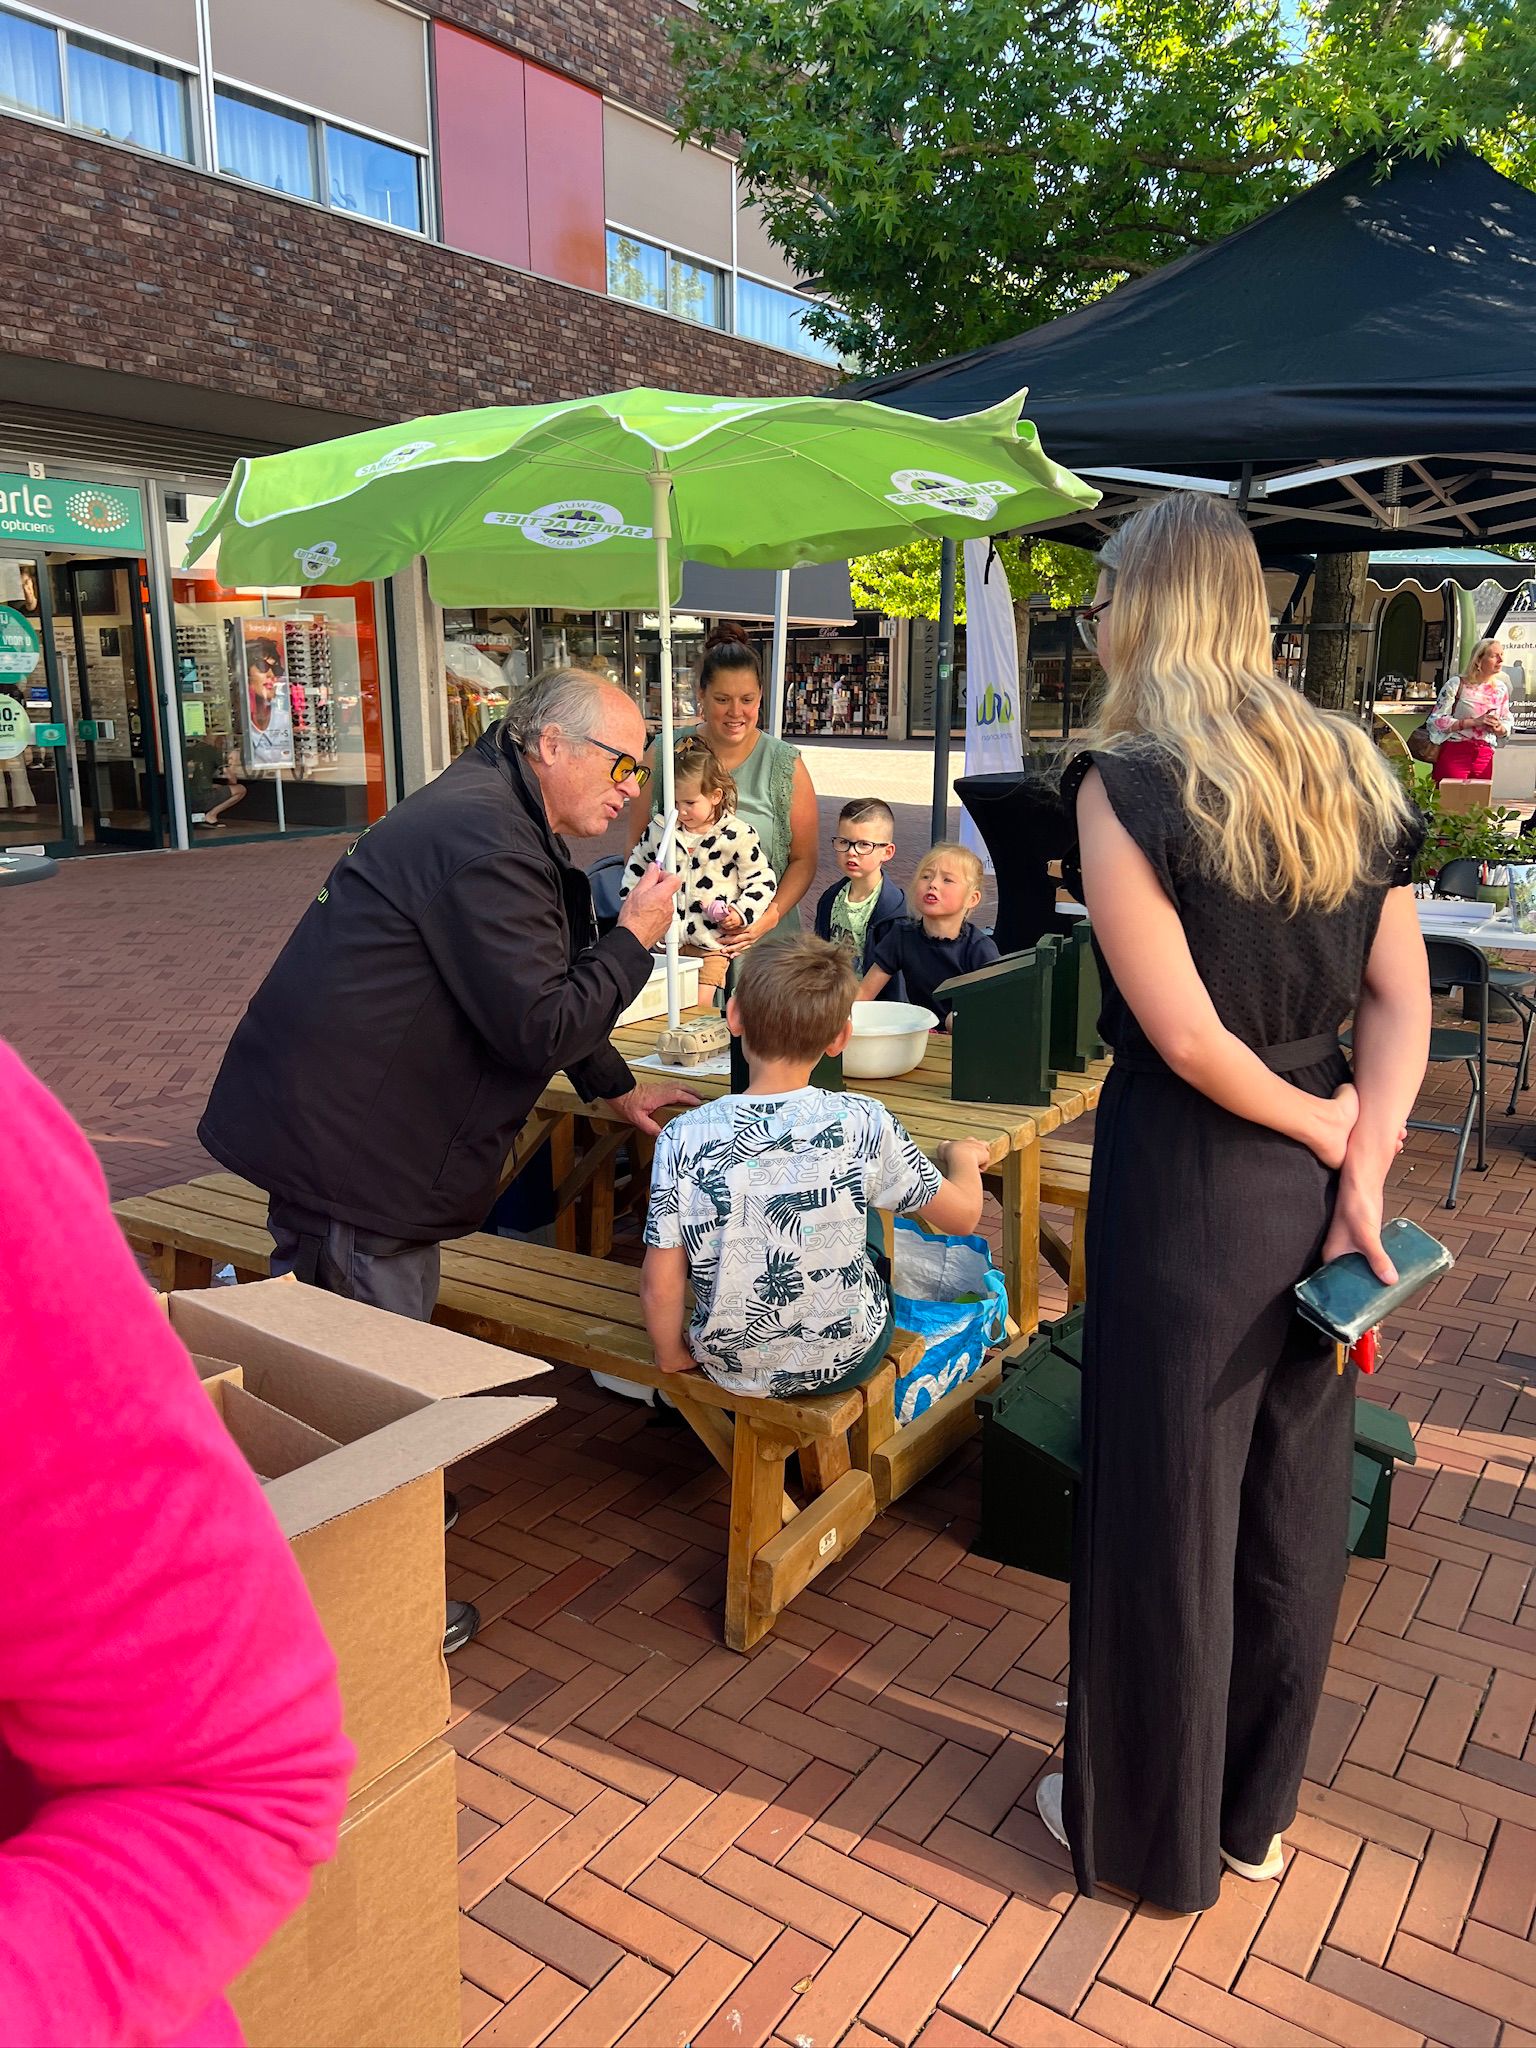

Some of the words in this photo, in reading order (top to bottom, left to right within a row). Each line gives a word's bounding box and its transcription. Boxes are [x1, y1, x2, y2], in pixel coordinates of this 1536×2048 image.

[33, 464, 41, 477] 5
[1, 519, 55, 533] opticiens
[747, 1162, 819, 1187] RVG
